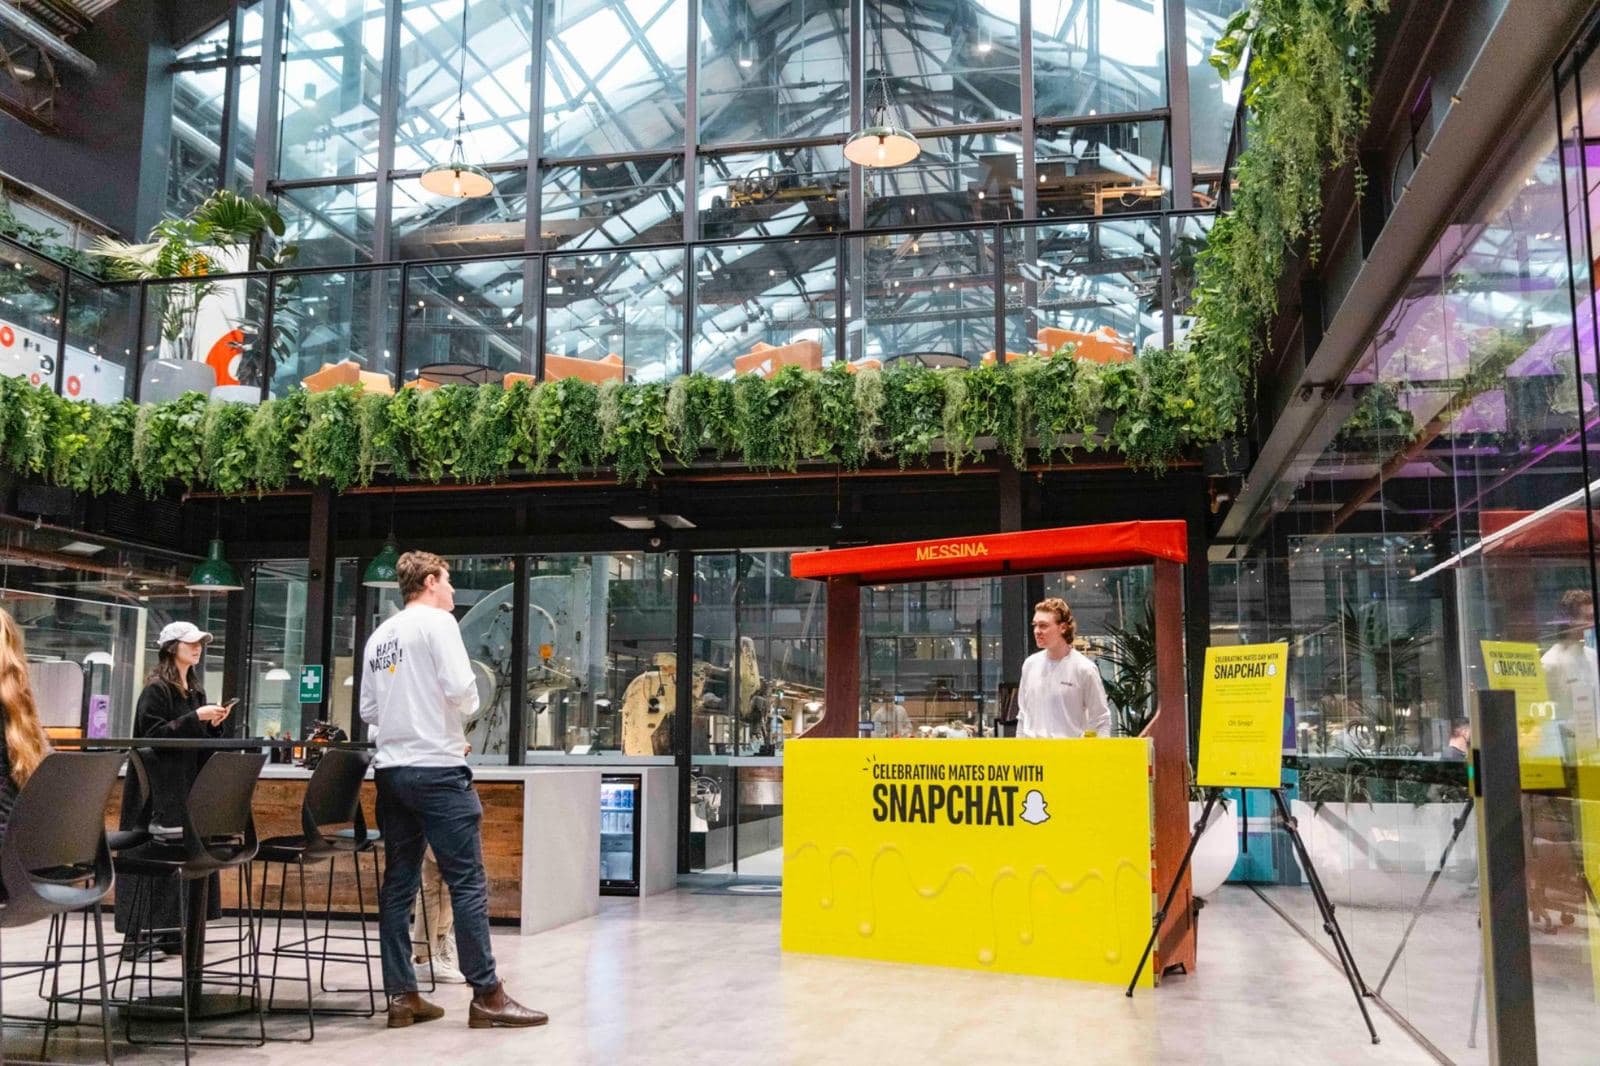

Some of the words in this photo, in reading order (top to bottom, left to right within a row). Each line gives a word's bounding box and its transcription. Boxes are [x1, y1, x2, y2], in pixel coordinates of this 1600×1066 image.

[915, 541, 989, 561] MESSINA
[1214, 662, 1267, 680] SNAPCHAT
[873, 763, 946, 780] CELEBRATING
[948, 764, 985, 781] MATES
[988, 765, 1011, 781] DAY
[1013, 765, 1044, 782] WITH
[872, 783, 1019, 827] SNAPCHAT
